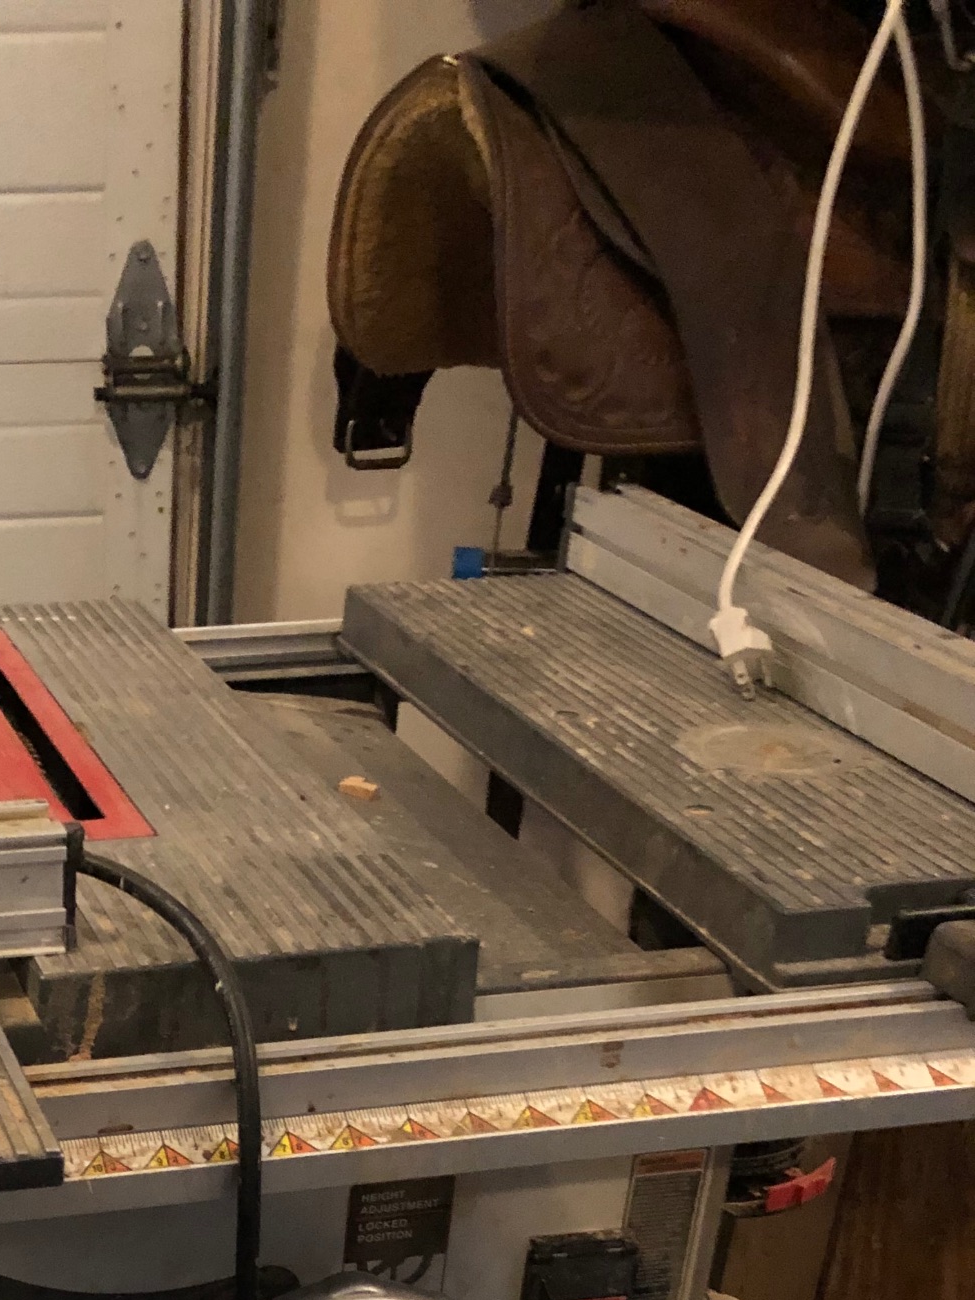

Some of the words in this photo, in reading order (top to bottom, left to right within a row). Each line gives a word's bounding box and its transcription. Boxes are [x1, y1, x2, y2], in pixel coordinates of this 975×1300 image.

[361, 1190, 405, 1203] HEIGHT
[360, 1199, 439, 1215] ADJUSTMENT
[358, 1218, 408, 1232] LOCKED
[357, 1230, 413, 1244] POSITION
